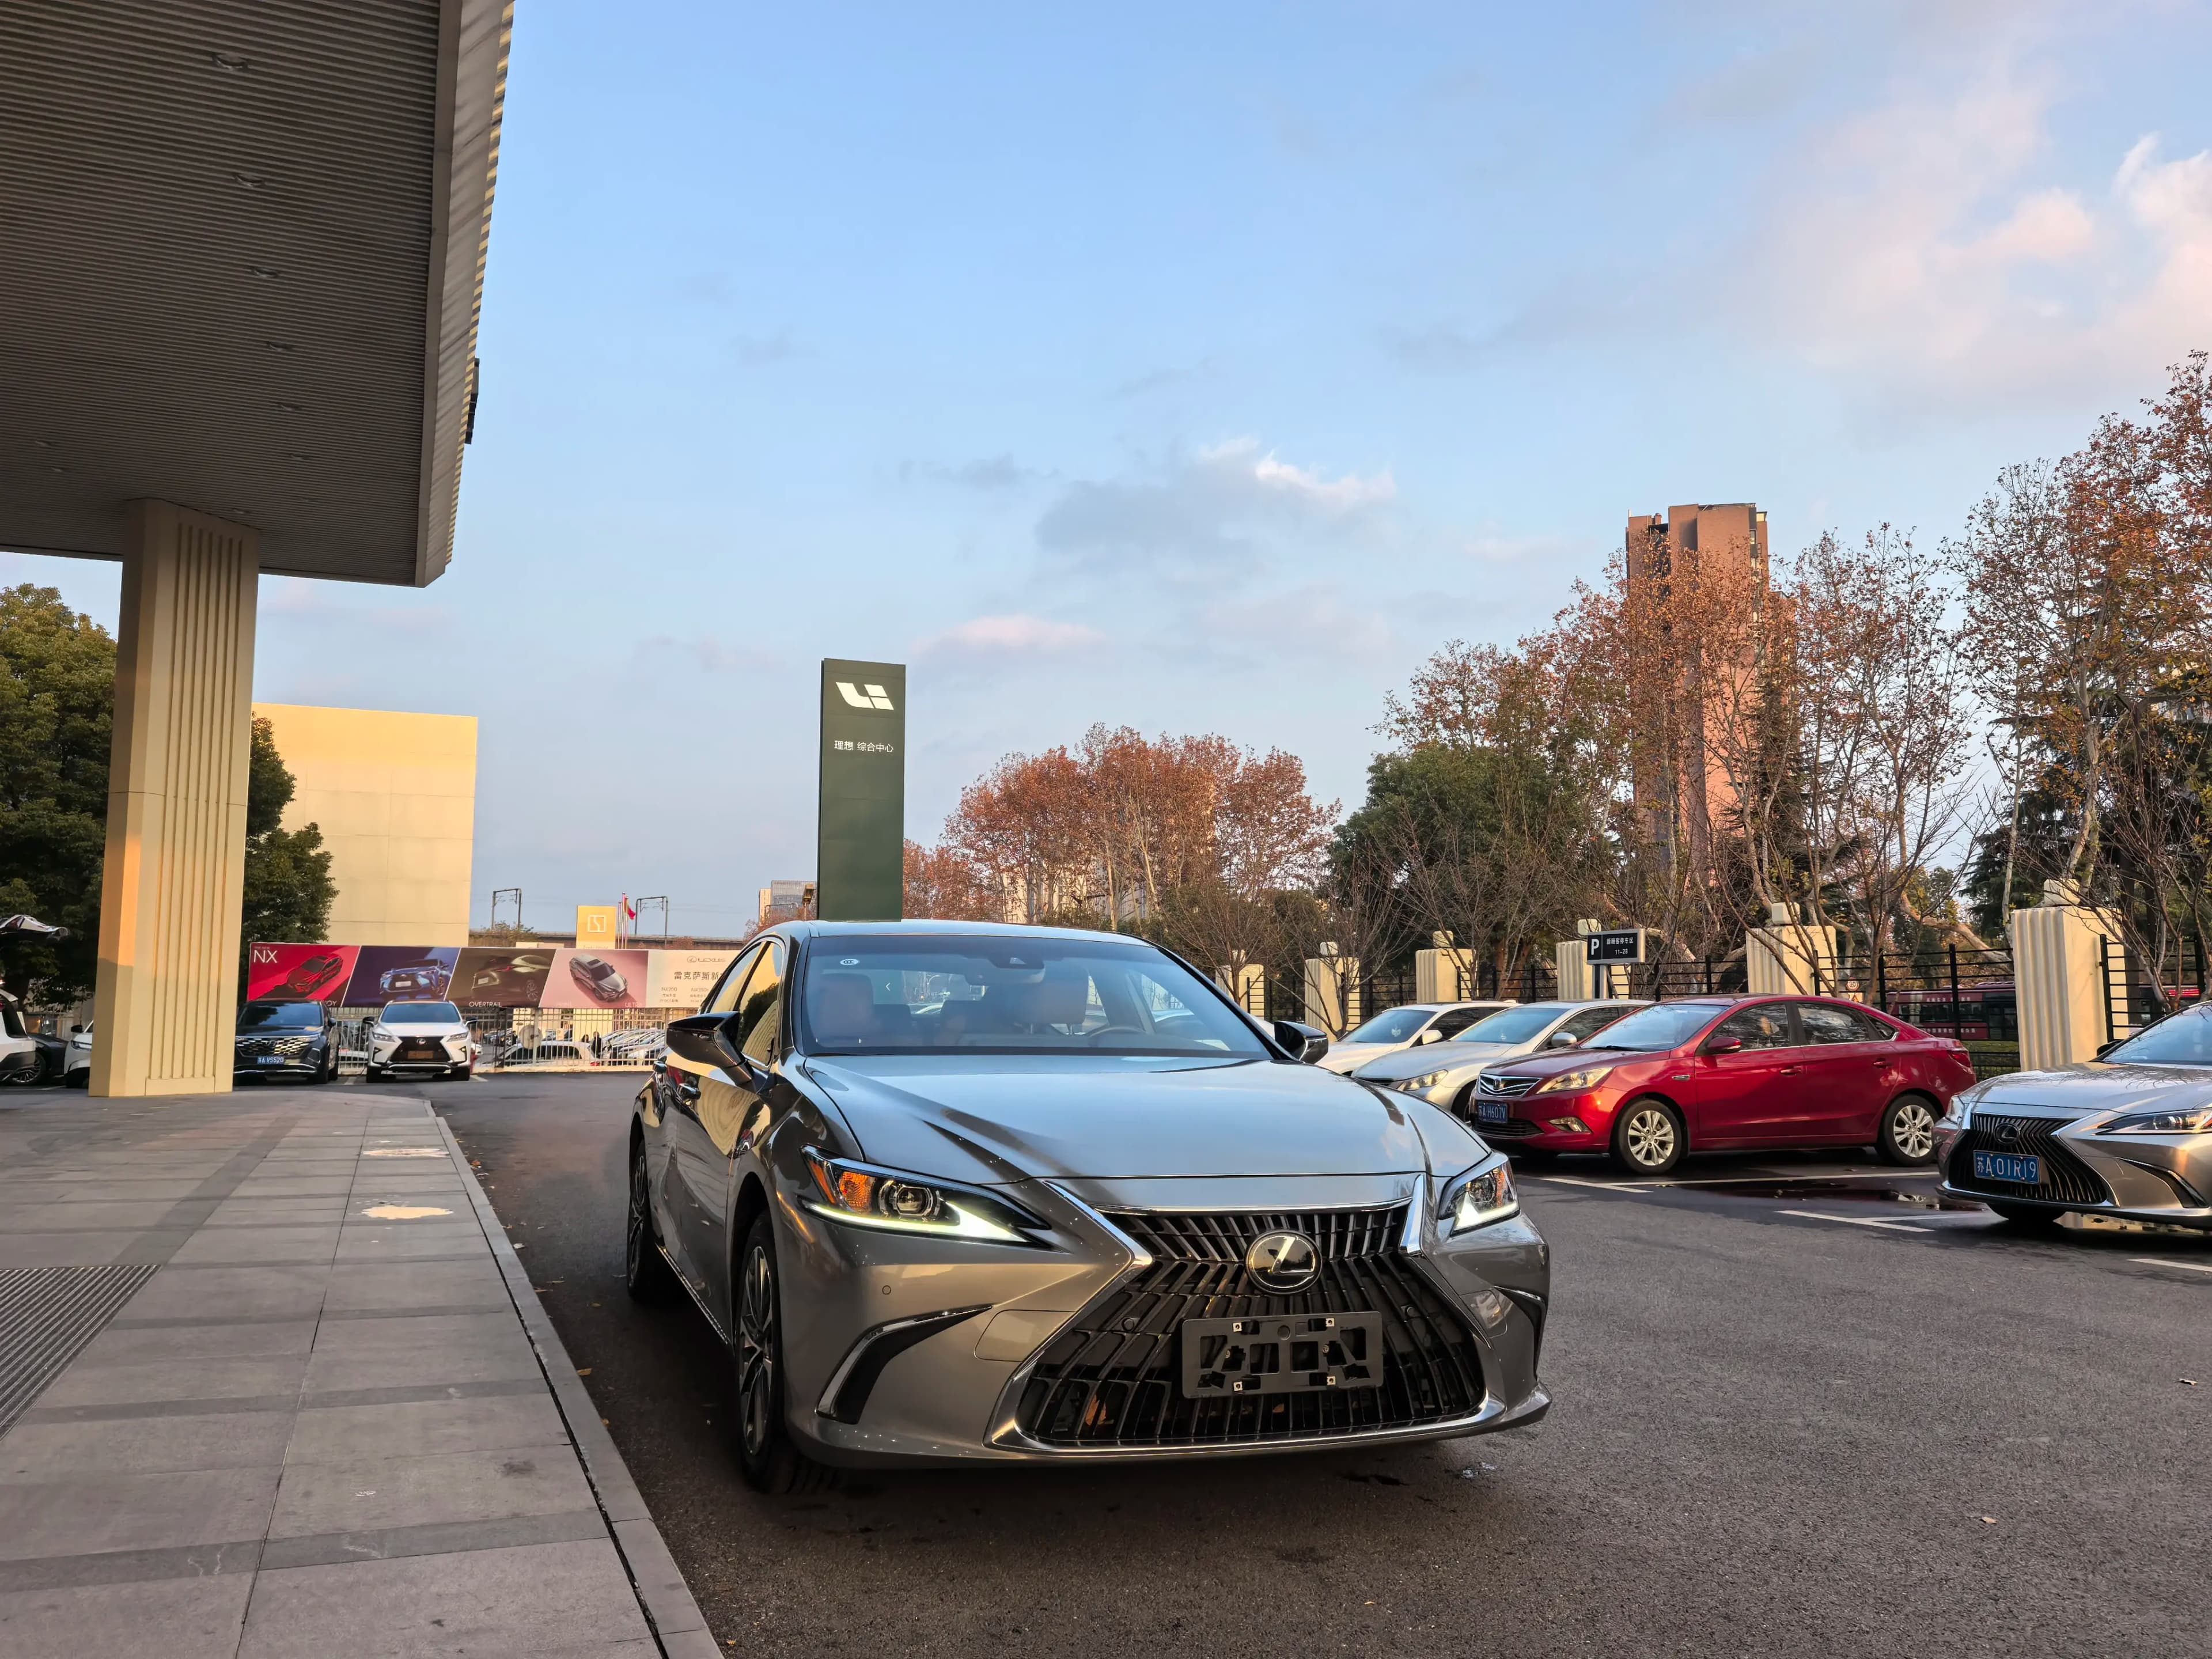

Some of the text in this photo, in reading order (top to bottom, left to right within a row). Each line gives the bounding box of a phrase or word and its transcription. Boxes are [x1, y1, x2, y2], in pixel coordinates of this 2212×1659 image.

[834, 740, 893, 753] 理想 综合中心
[1590, 938, 1599, 955] P
[253, 949, 278, 963] NX
[674, 971, 722, 980] 雷克萨斯新
